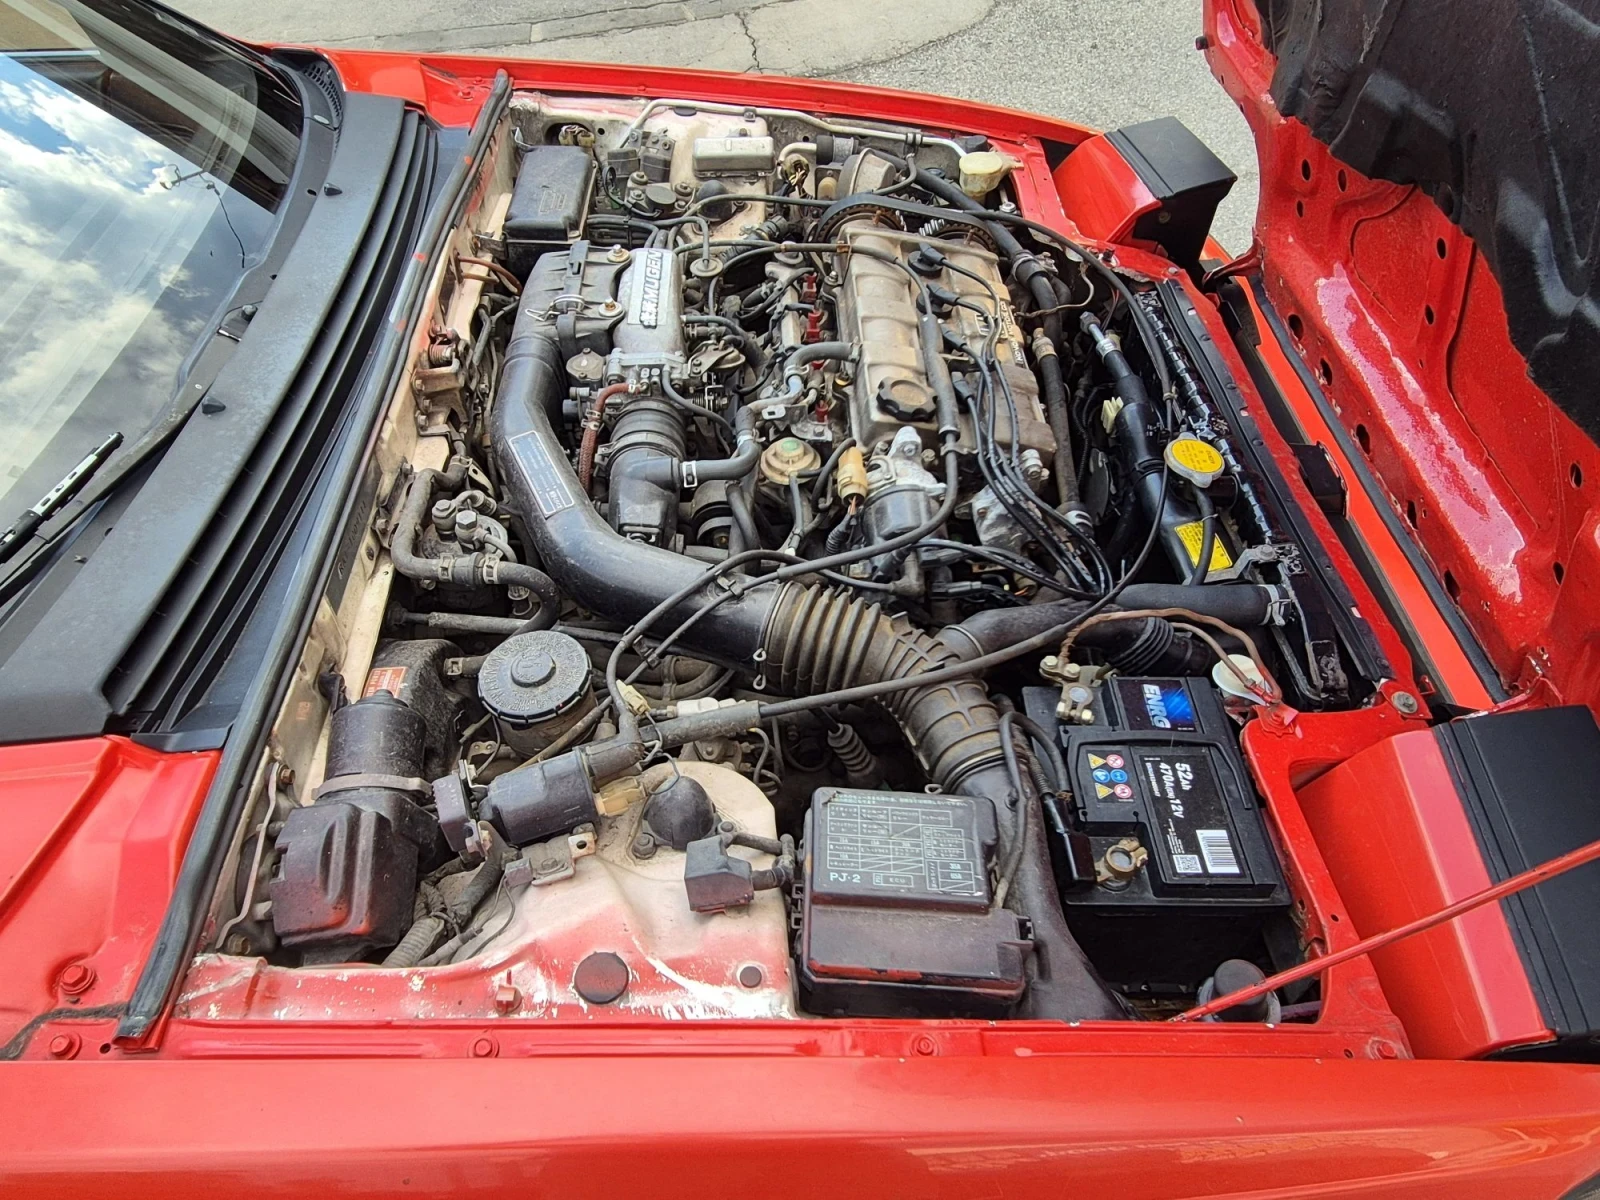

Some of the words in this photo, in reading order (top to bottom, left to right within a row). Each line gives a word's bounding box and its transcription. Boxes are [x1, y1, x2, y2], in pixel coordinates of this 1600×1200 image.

[643, 249, 662, 303] MUGEN
[484, 648, 509, 697] WARNING
[1143, 684, 1171, 728] ENRG
[1175, 762, 1193, 791] 52Ah
[1170, 798, 1184, 818] 12V
